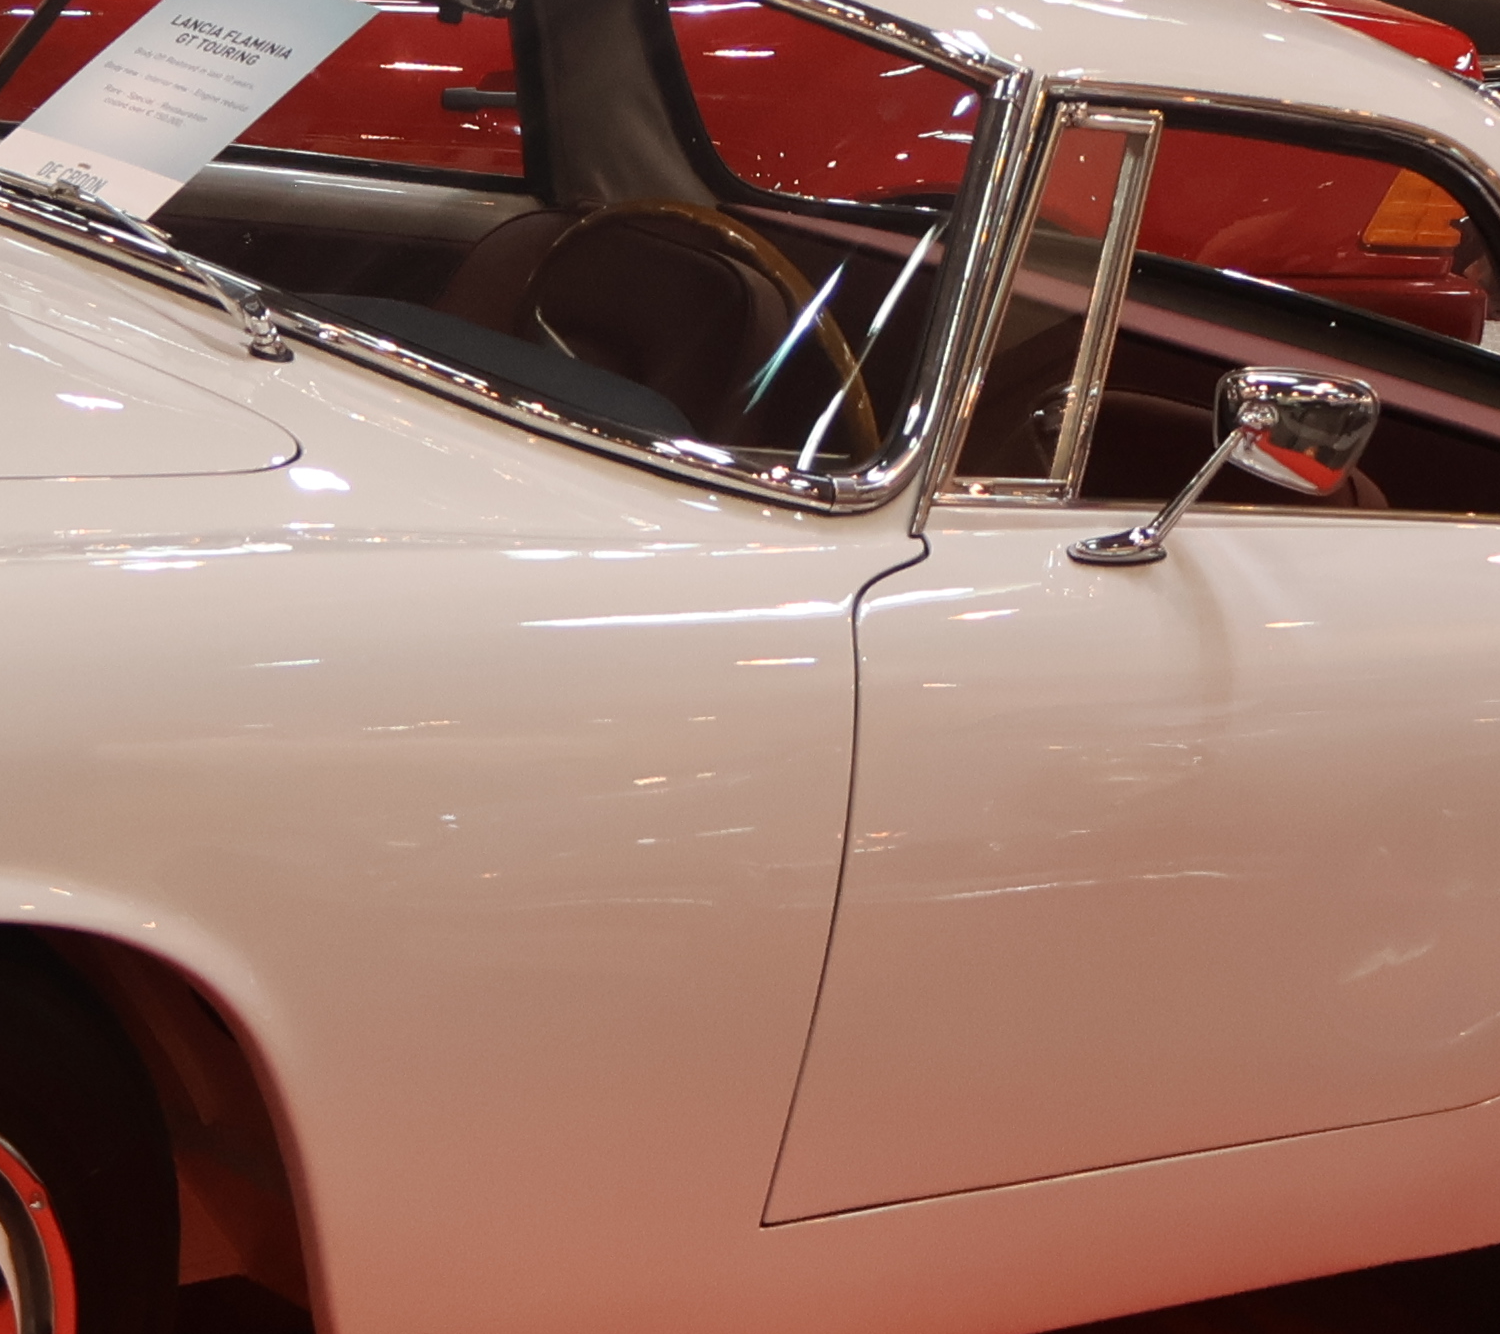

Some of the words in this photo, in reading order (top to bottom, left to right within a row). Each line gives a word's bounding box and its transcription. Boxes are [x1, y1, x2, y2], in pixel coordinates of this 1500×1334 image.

[171, 14, 224, 38] LANCIA
[224, 30, 293, 60] FLAMINIA
[175, 33, 200, 46] GT
[196, 38, 260, 66] TOURING
